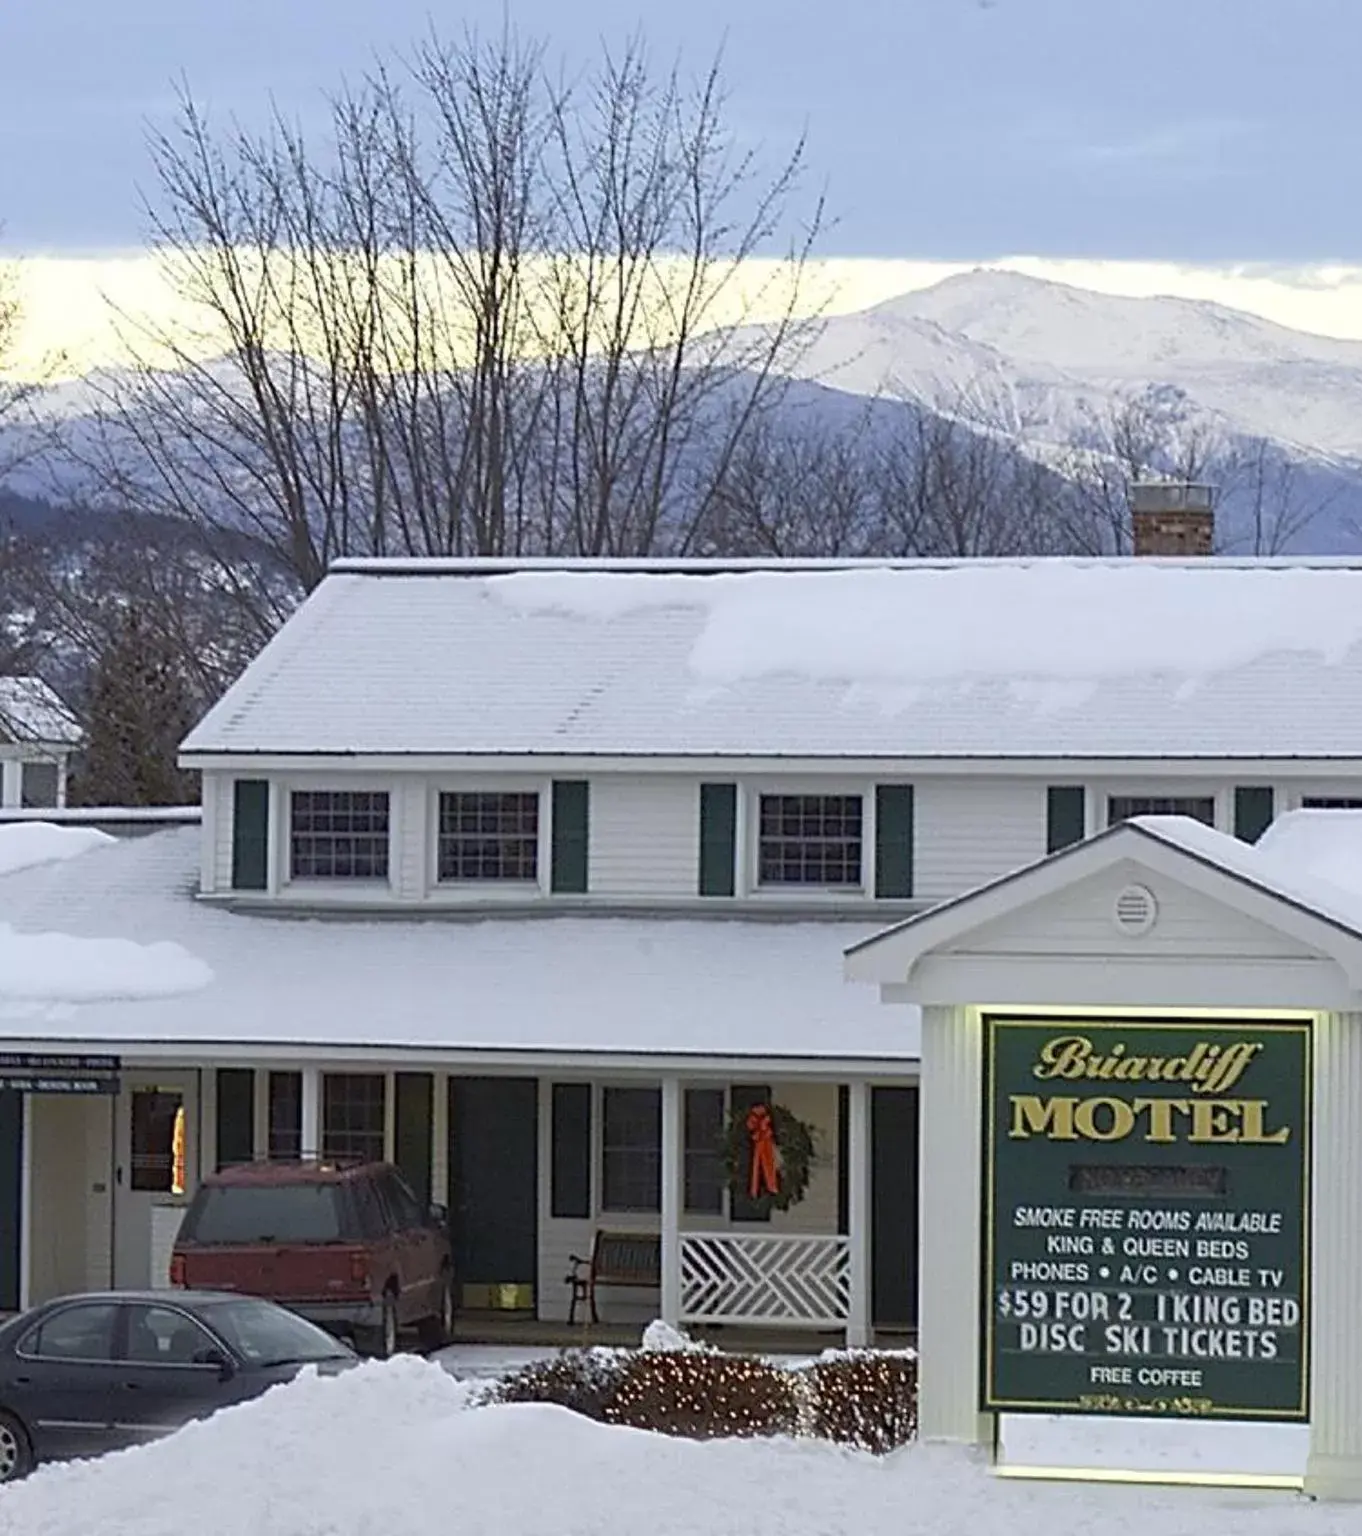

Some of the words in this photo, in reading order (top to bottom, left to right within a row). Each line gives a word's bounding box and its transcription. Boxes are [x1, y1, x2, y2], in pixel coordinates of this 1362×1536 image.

[1008, 1095, 1290, 1144] MOTEL
[1014, 1207, 1076, 1227] SMOKE
[1080, 1208, 1124, 1229] FREE
[1128, 1210, 1191, 1231] ROOMS
[1195, 1211, 1282, 1233] AVAILABLE
[1047, 1235, 1093, 1254] KING
[1101, 1237, 1115, 1255] &
[1123, 1237, 1190, 1258] QUEEN
[1197, 1240, 1249, 1260] BEDS
[1012, 1262, 1089, 1281] PHONES
[1120, 1264, 1158, 1284] A/C
[1189, 1266, 1251, 1286] CABLE
[1258, 1268, 1283, 1288] TV
[999, 1290, 1048, 1318] $59
[1056, 1291, 1109, 1321] FOR
[1118, 1292, 1132, 1320] 2
[1173, 1295, 1241, 1324] KING
[1249, 1298, 1300, 1326] BED
[1021, 1323, 1084, 1352] DISC
[1105, 1325, 1150, 1354] SKI
[1163, 1327, 1277, 1359] TICKETS
[1090, 1367, 1132, 1384] FREE
[1138, 1367, 1202, 1387] COFFEE
